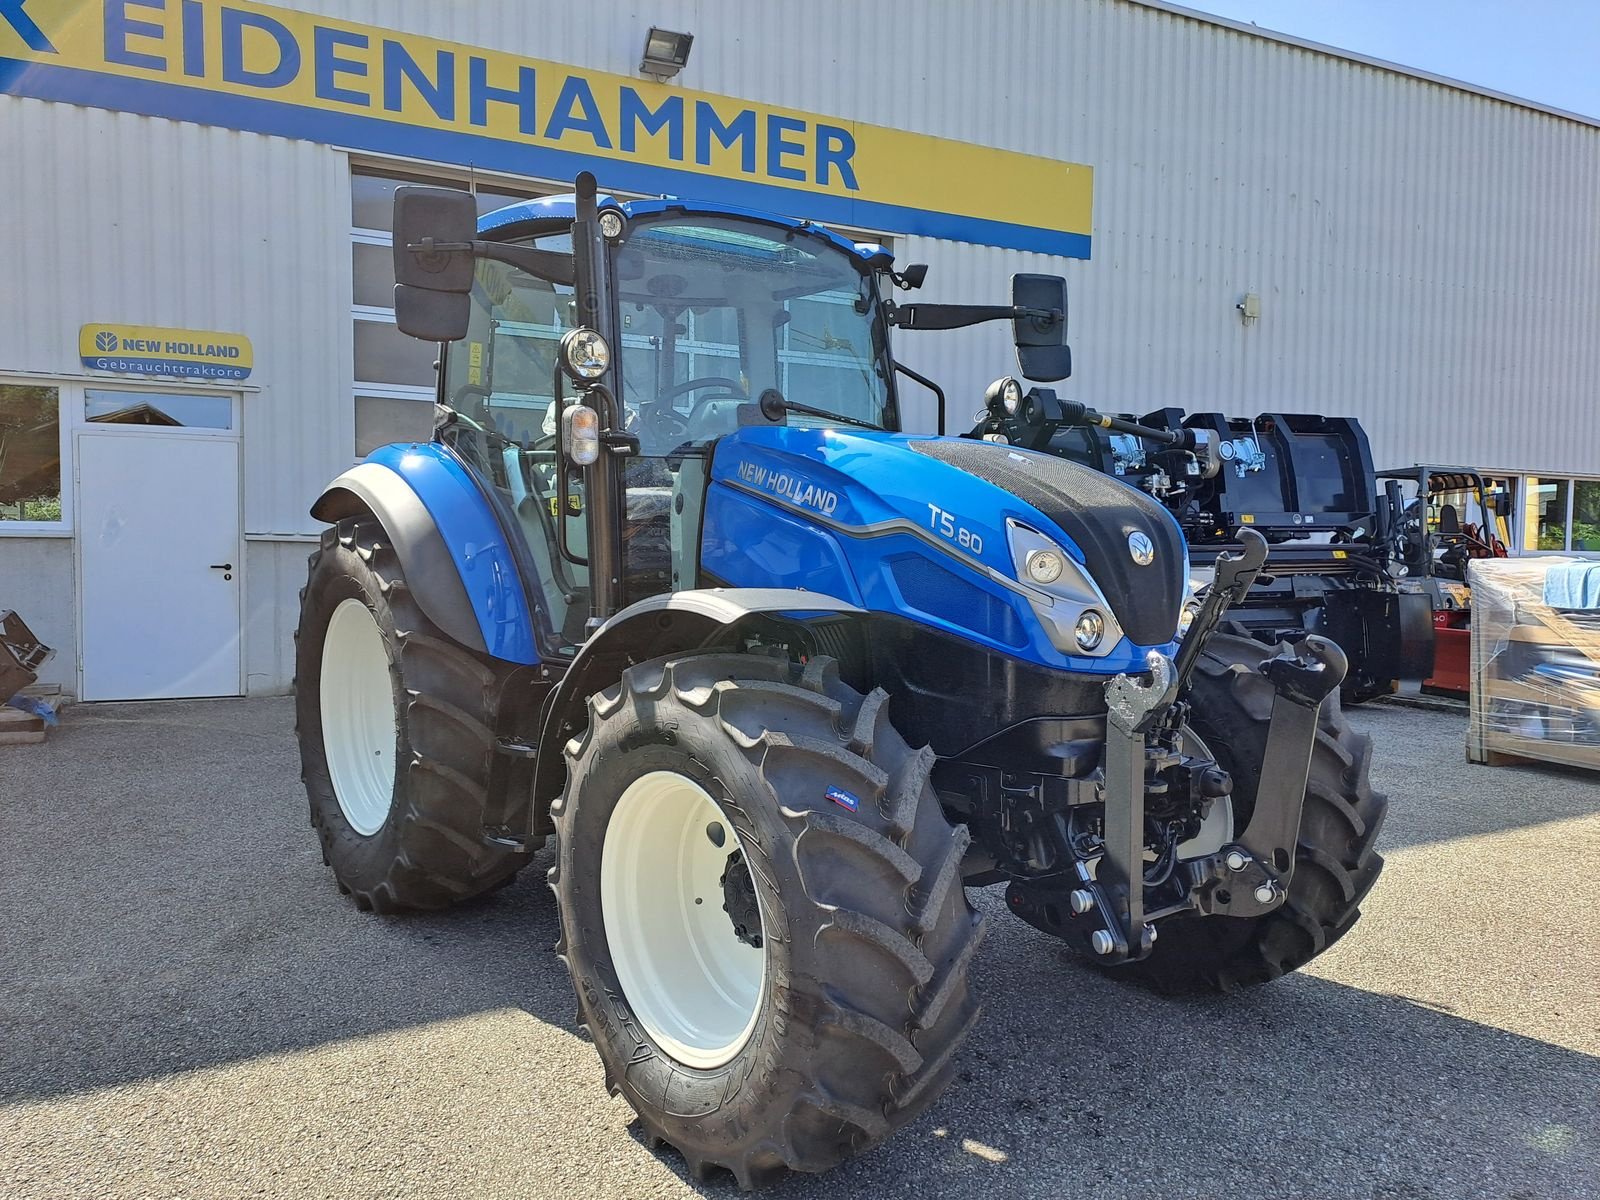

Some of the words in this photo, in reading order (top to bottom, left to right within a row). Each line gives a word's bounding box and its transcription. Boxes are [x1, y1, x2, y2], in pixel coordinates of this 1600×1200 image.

[103, 0, 860, 191] EIDENHAMMER
[96, 357, 241, 377] Gebrauchttraktore
[122, 338, 161, 353] NEW
[165, 342, 240, 358] HOLLAND
[737, 460, 768, 485] NEW
[766, 471, 838, 515] HOLLAND
[927, 502, 983, 556] T5.80
